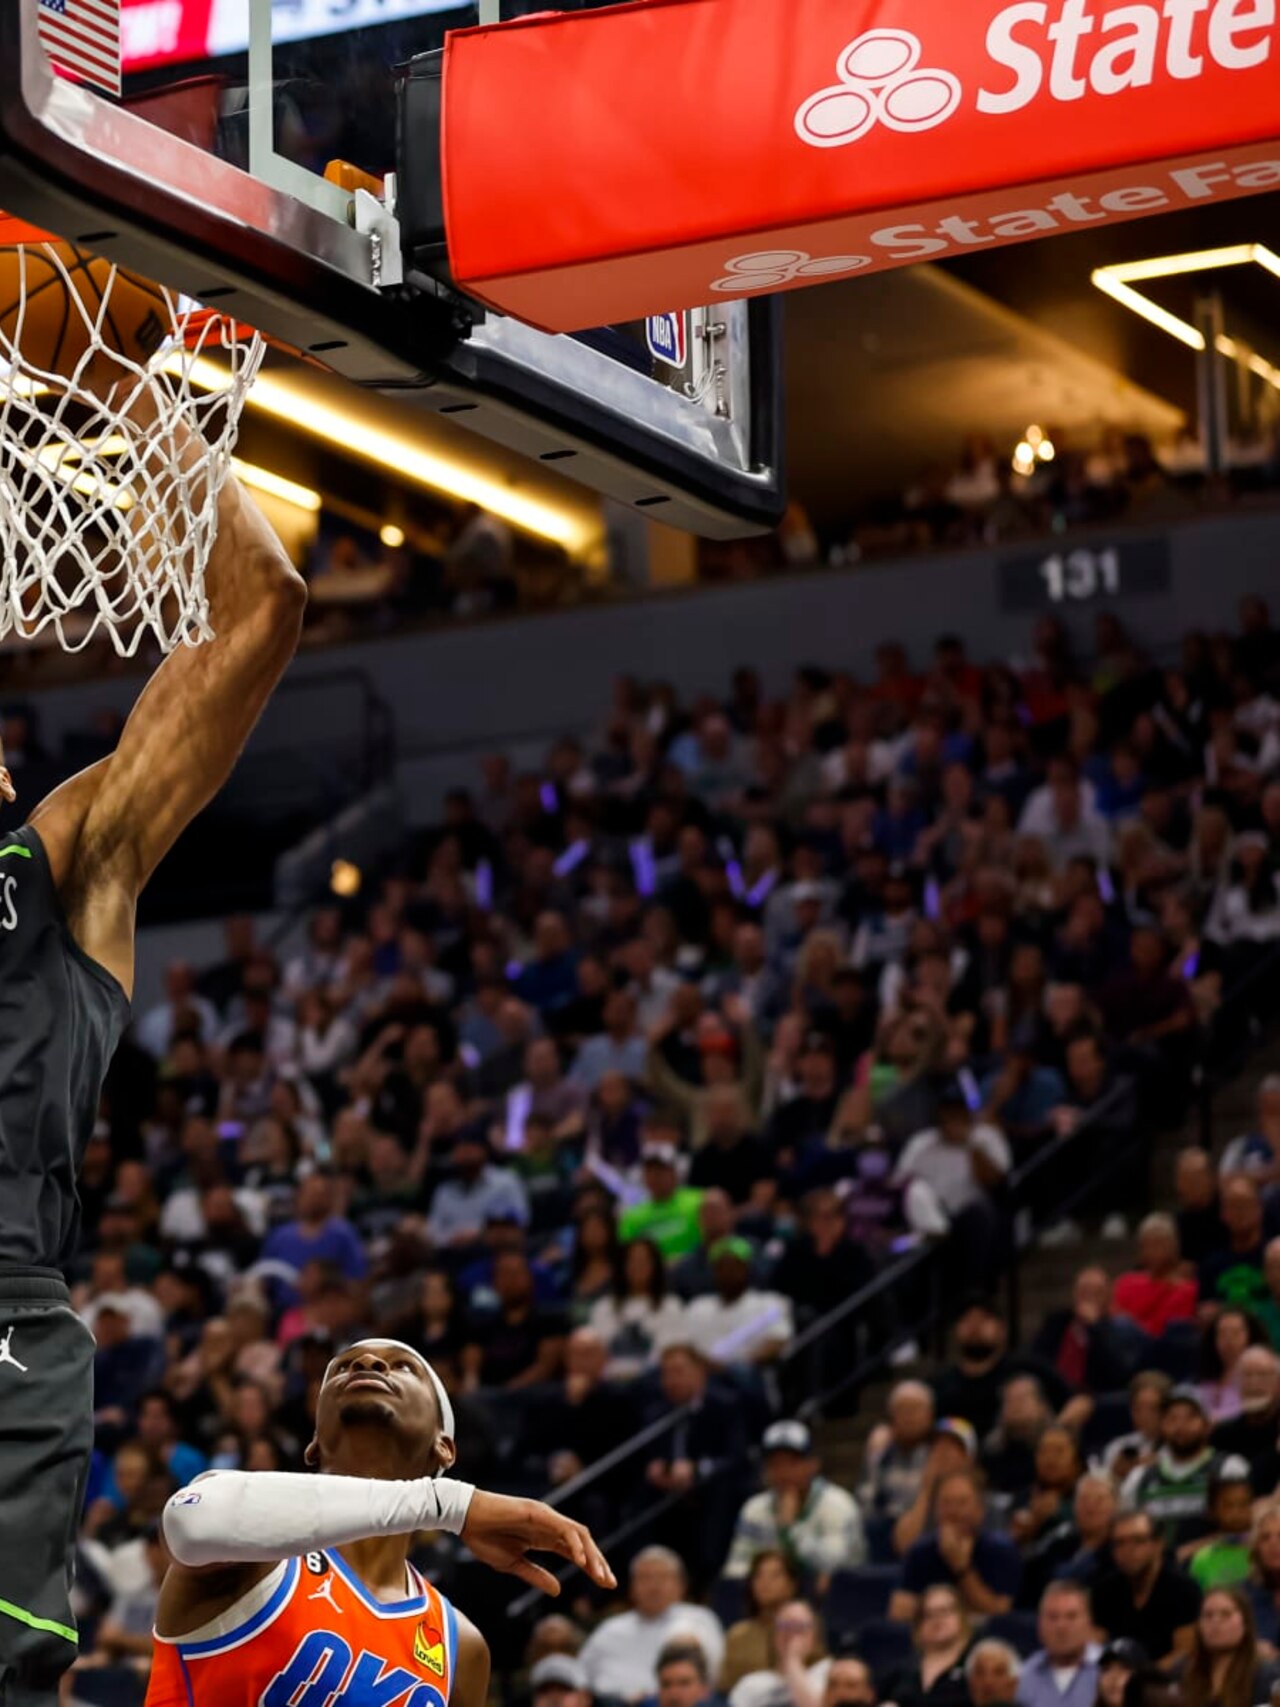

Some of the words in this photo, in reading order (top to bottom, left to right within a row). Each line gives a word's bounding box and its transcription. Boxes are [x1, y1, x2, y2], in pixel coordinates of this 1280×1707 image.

[976, 0, 1276, 114] State
[870, 186, 1169, 258] State
[652, 315, 672, 351] NBA
[307, 1551, 321, 1573] 6
